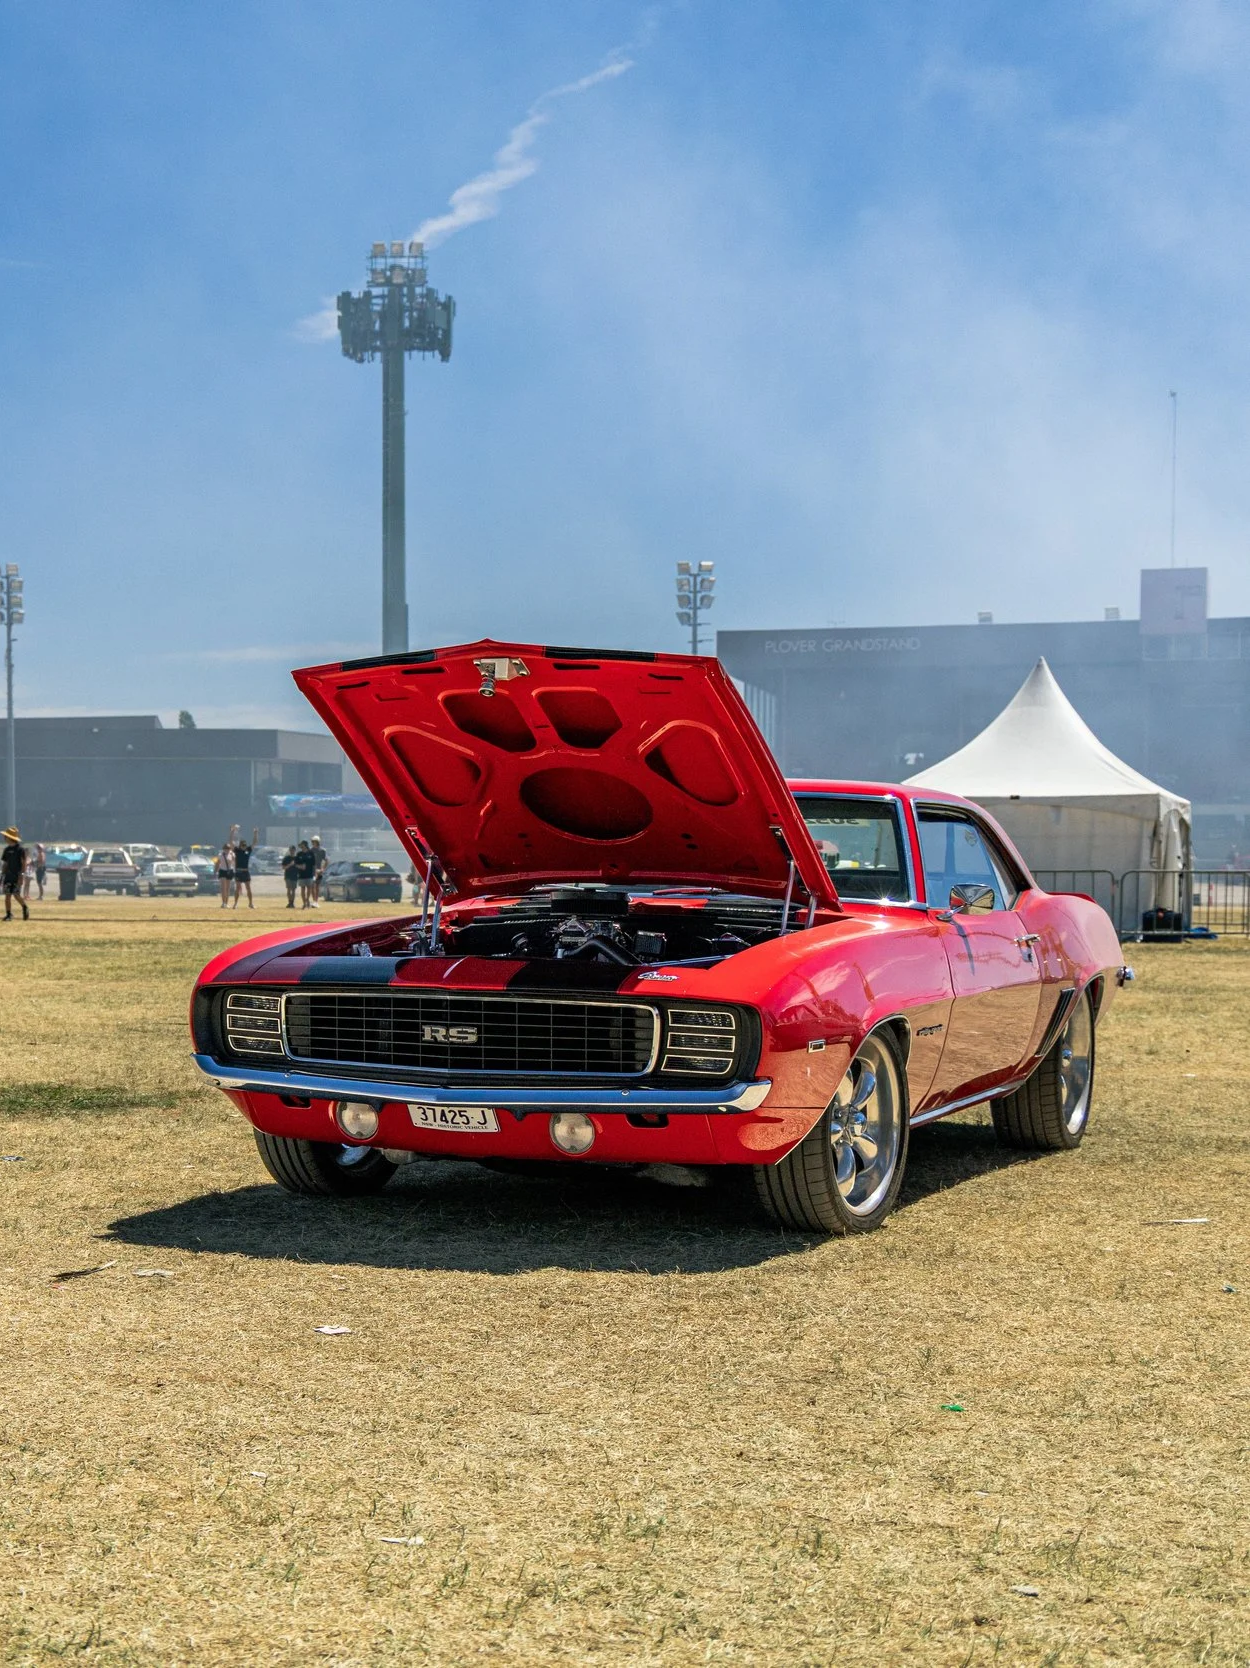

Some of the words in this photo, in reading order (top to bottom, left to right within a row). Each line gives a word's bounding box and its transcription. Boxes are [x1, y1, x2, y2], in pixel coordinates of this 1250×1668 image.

[764, 639, 816, 653] PLOVER
[822, 637, 921, 652] GRANDSTAND
[422, 1025, 478, 1044] RS
